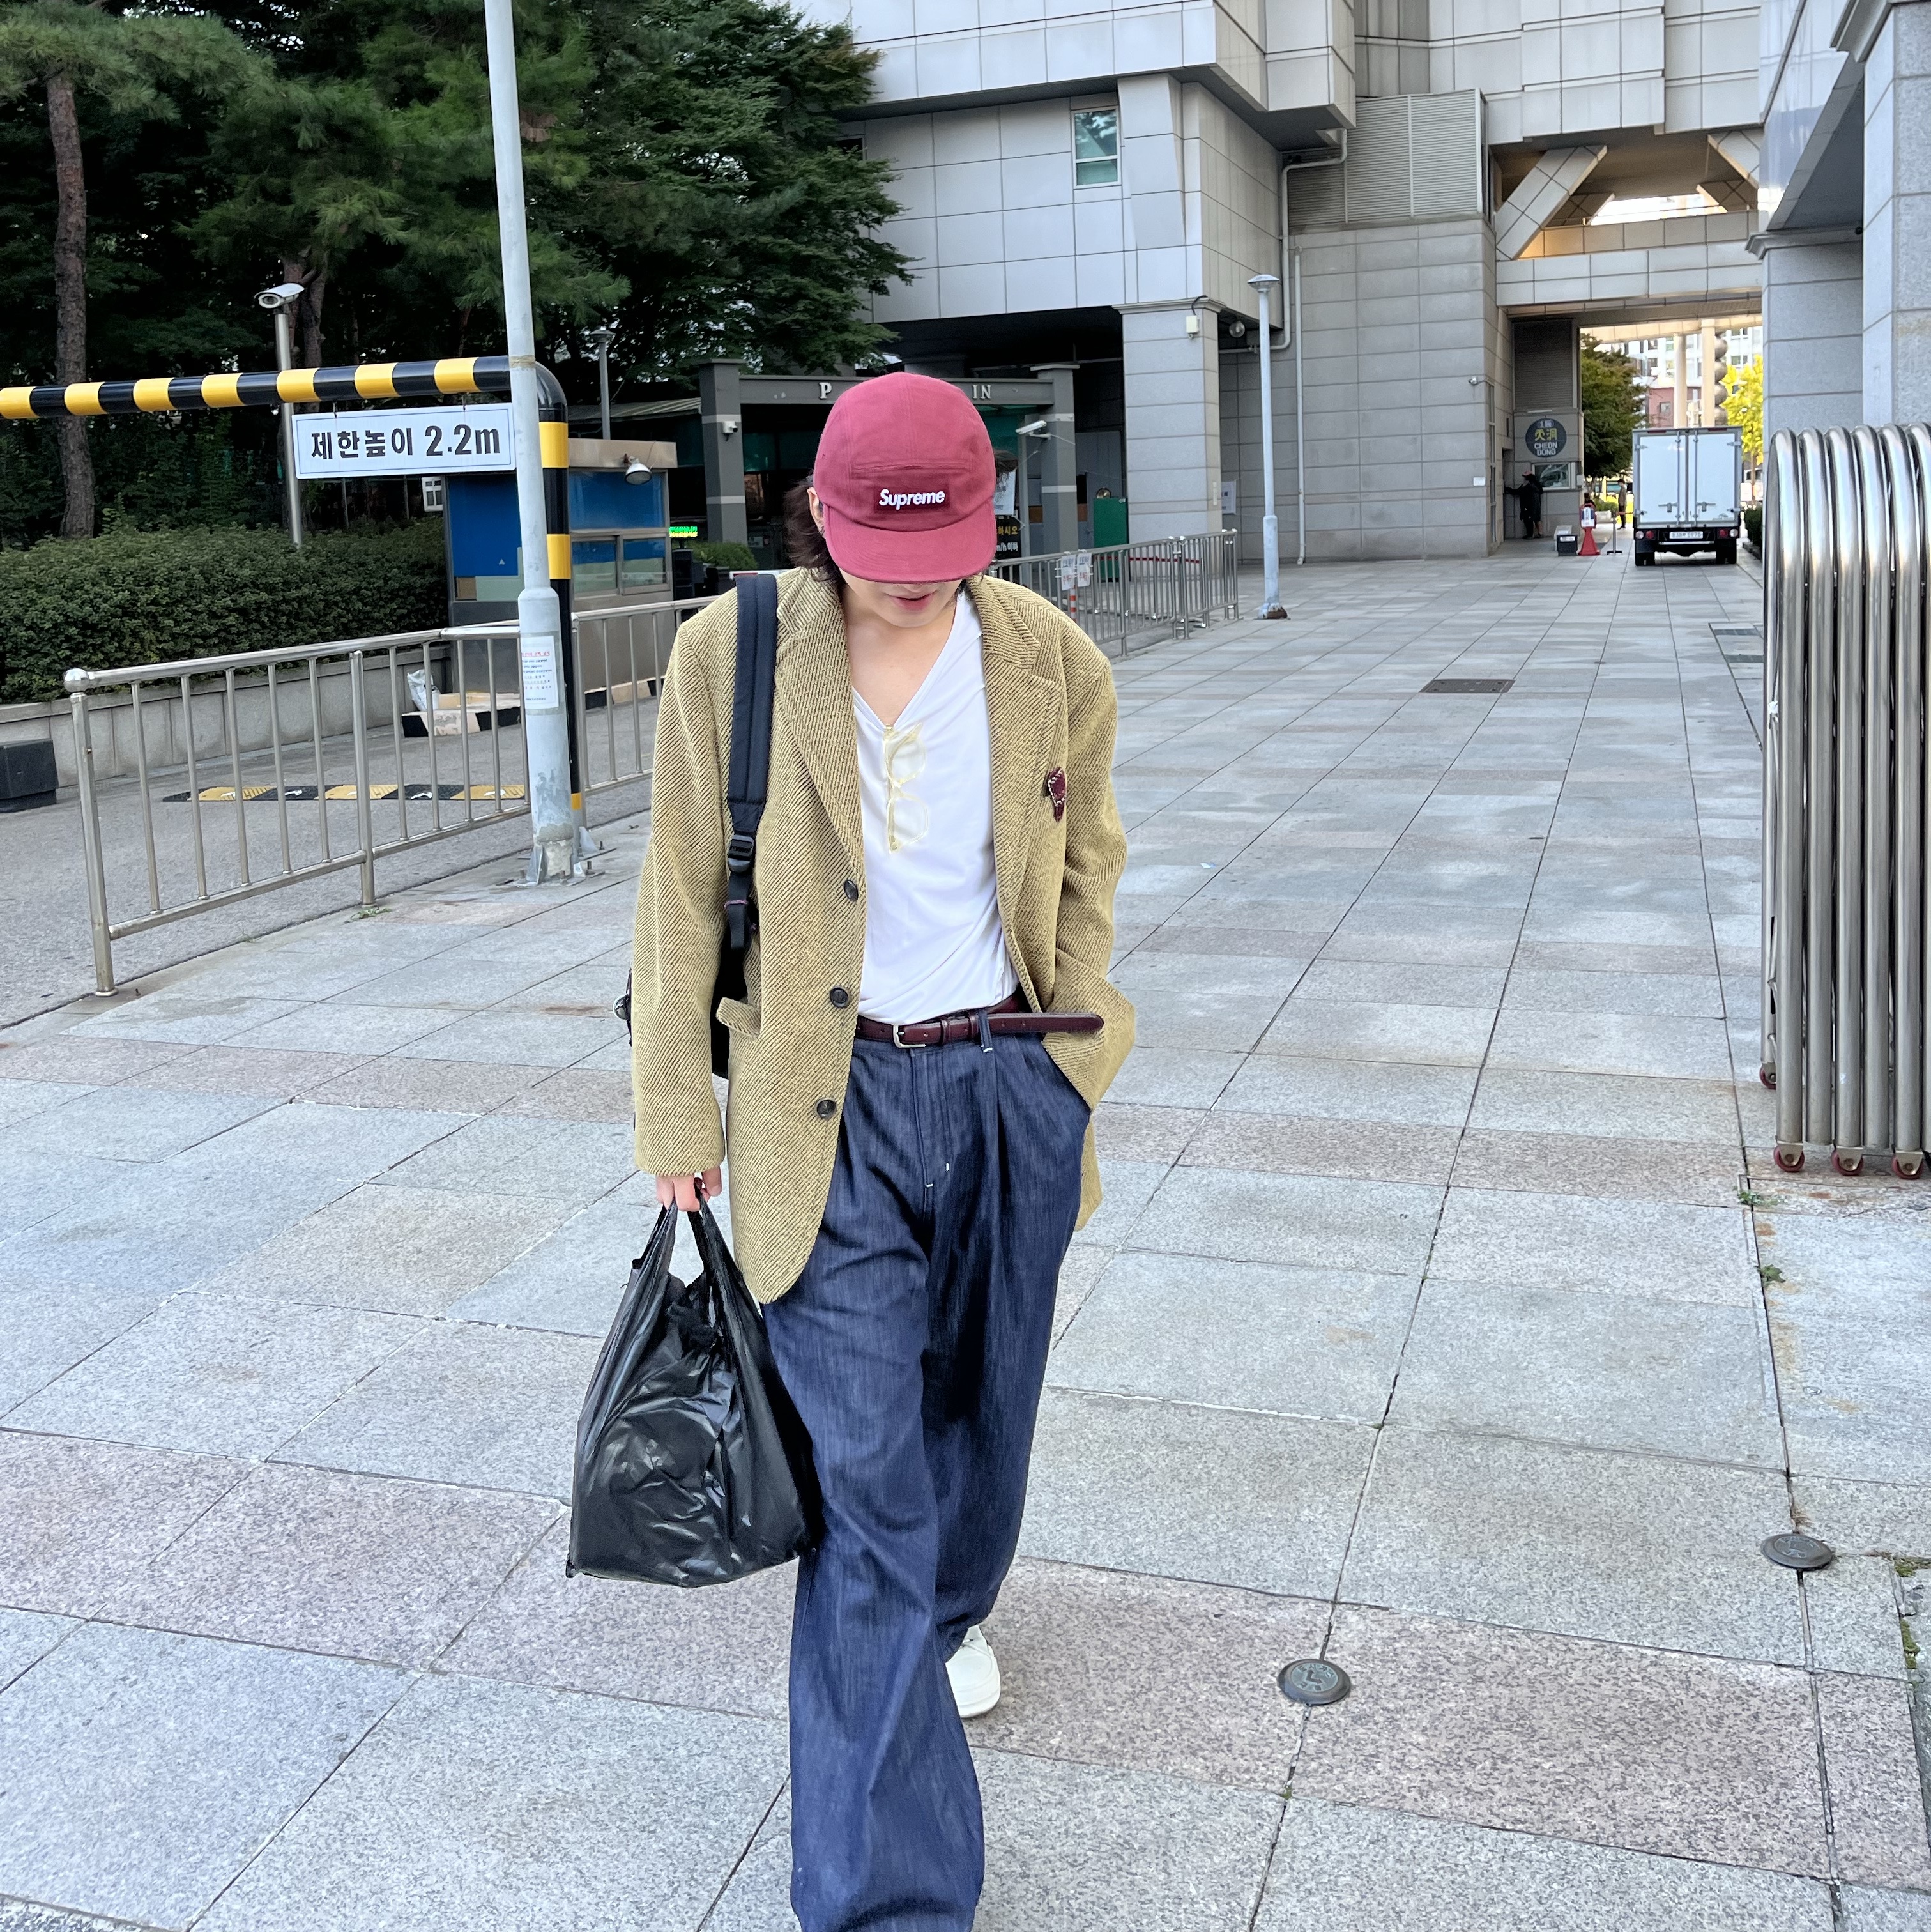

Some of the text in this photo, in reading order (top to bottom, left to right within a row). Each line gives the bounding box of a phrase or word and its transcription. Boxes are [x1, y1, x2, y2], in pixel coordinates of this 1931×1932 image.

[311, 424, 500, 459] 제한높이 2.2m
[1534, 441, 1557, 450] CHEON
[878, 488, 945, 510] Supreme
